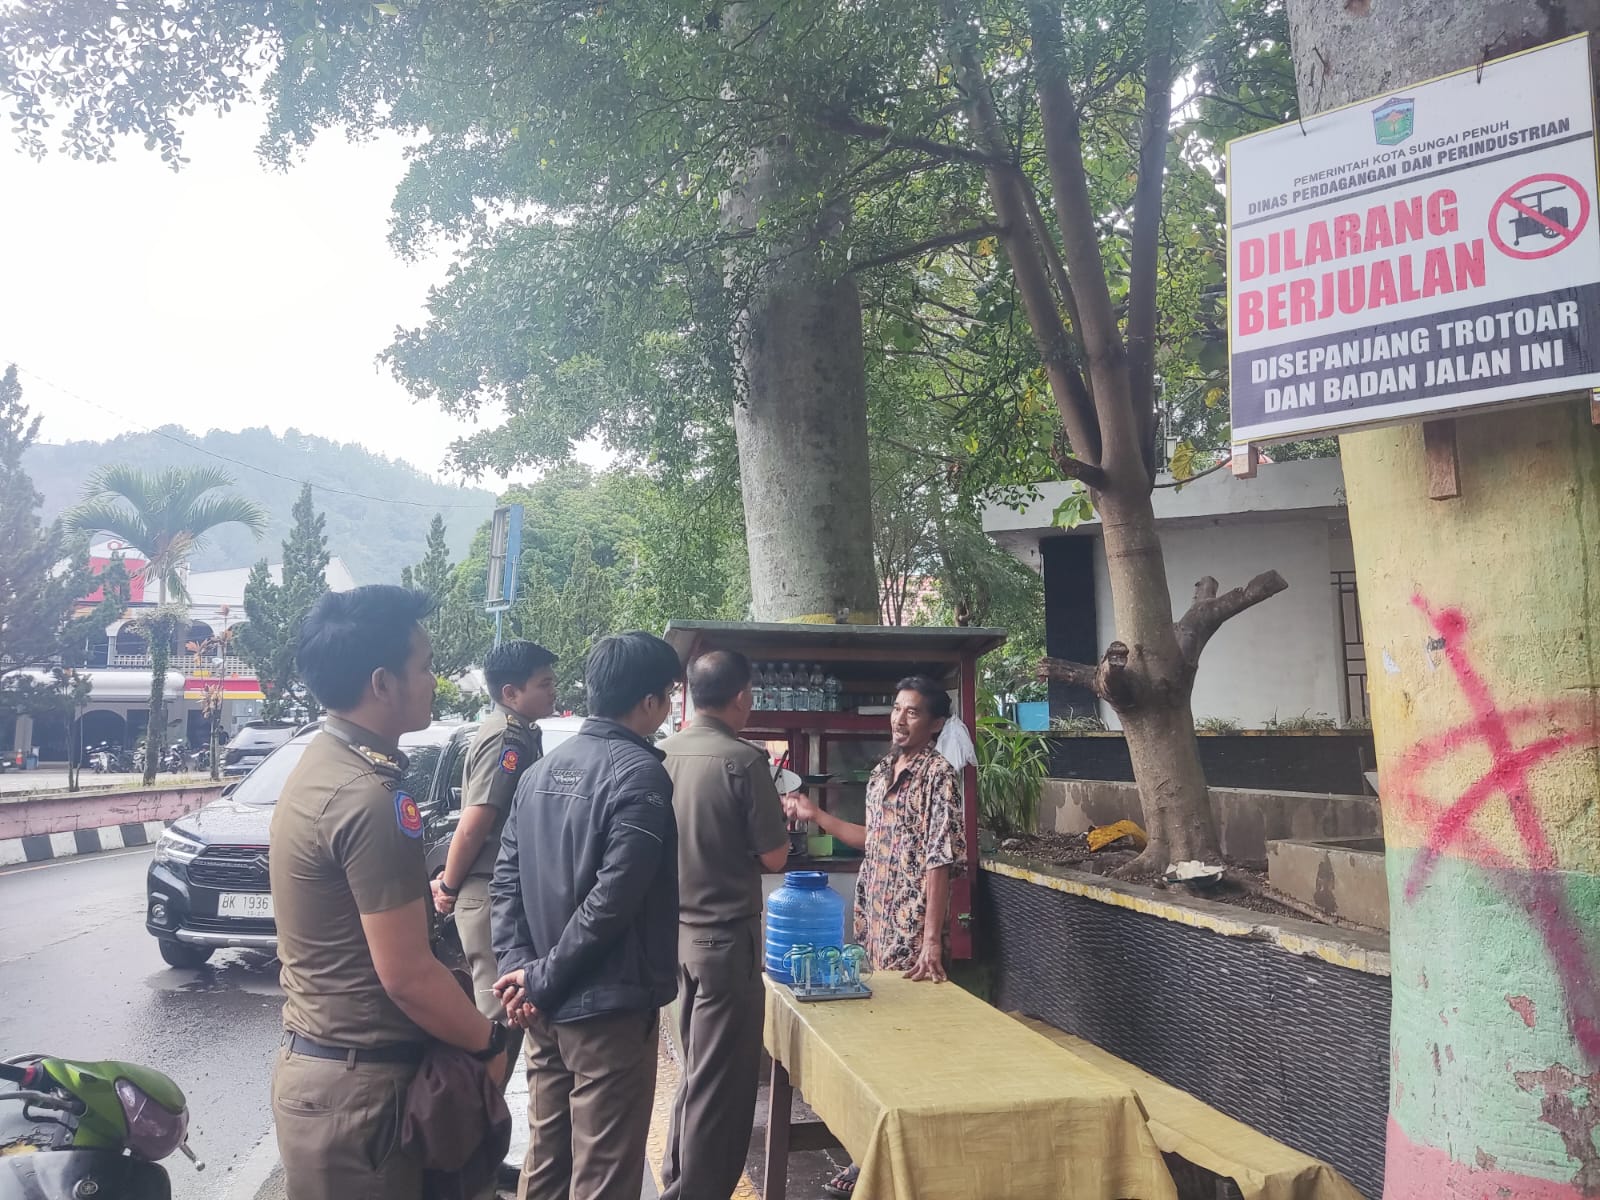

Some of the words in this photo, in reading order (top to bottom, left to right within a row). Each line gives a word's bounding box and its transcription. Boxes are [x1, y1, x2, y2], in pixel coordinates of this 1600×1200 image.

[1248, 194, 1289, 216] DINAS
[1292, 165, 1397, 203] PERDAGANGAN
[1402, 153, 1432, 173] DAN
[1437, 117, 1570, 165] PERINDUSTRIAN
[1293, 158, 1369, 187] PEMERINTAH
[1373, 149, 1406, 164] KOTA
[1409, 136, 1459, 155] SUNGAI
[1463, 120, 1510, 140] PENUH
[1239, 189, 1459, 282] DILARANG
[1238, 239, 1486, 337] BERJUALAN
[1251, 327, 1430, 384] DISEPANJANG
[1436, 300, 1579, 347] TROTOAR
[1264, 384, 1316, 414] DAN
[1323, 364, 1417, 404] BADAN
[1424, 350, 1511, 387] JALAN
[1519, 339, 1565, 371] INI
[222, 896, 236, 909] BK
[243, 896, 269, 910] 1936
